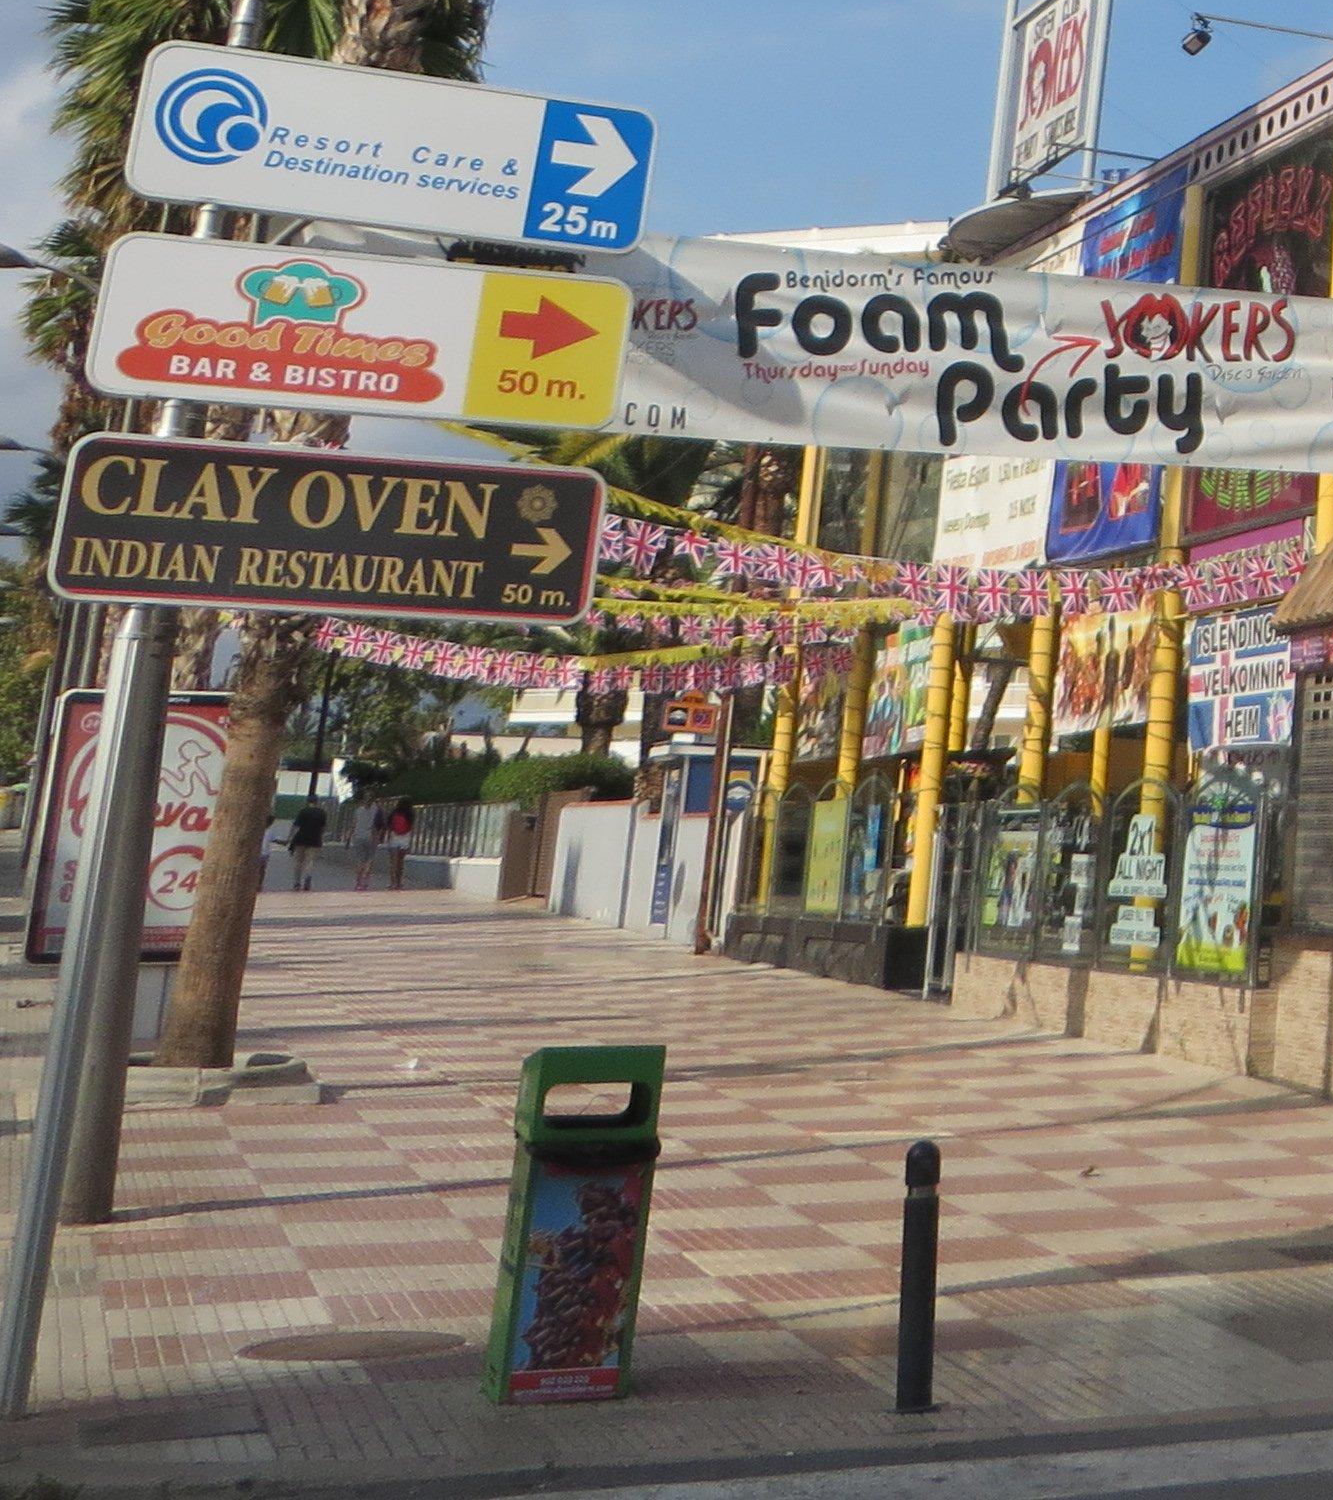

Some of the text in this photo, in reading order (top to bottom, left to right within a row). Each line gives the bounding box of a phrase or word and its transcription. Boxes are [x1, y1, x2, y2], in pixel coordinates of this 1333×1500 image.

[263, 150, 520, 200] Destination services
[267, 125, 519, 176] Resort Care &
[786, 267, 903, 292] Benidorm's
[144, 313, 429, 367] Good Times
[735, 271, 1025, 374] Foam
[1100, 293, 1296, 361] JOKERS
[168, 354, 401, 394] BAR & BISTRO
[497, 369, 539, 396] 50
[743, 361, 837, 384] Thursday
[936, 360, 1205, 454] Party
[81, 455, 500, 540] CLAY OVEN
[68, 536, 485, 600] INDIAN RESTAURANT
[501, 583, 532, 606] 50
[1201, 659, 1286, 697] VELKOMNIR
[1224, 705, 1259, 740] HEIM
